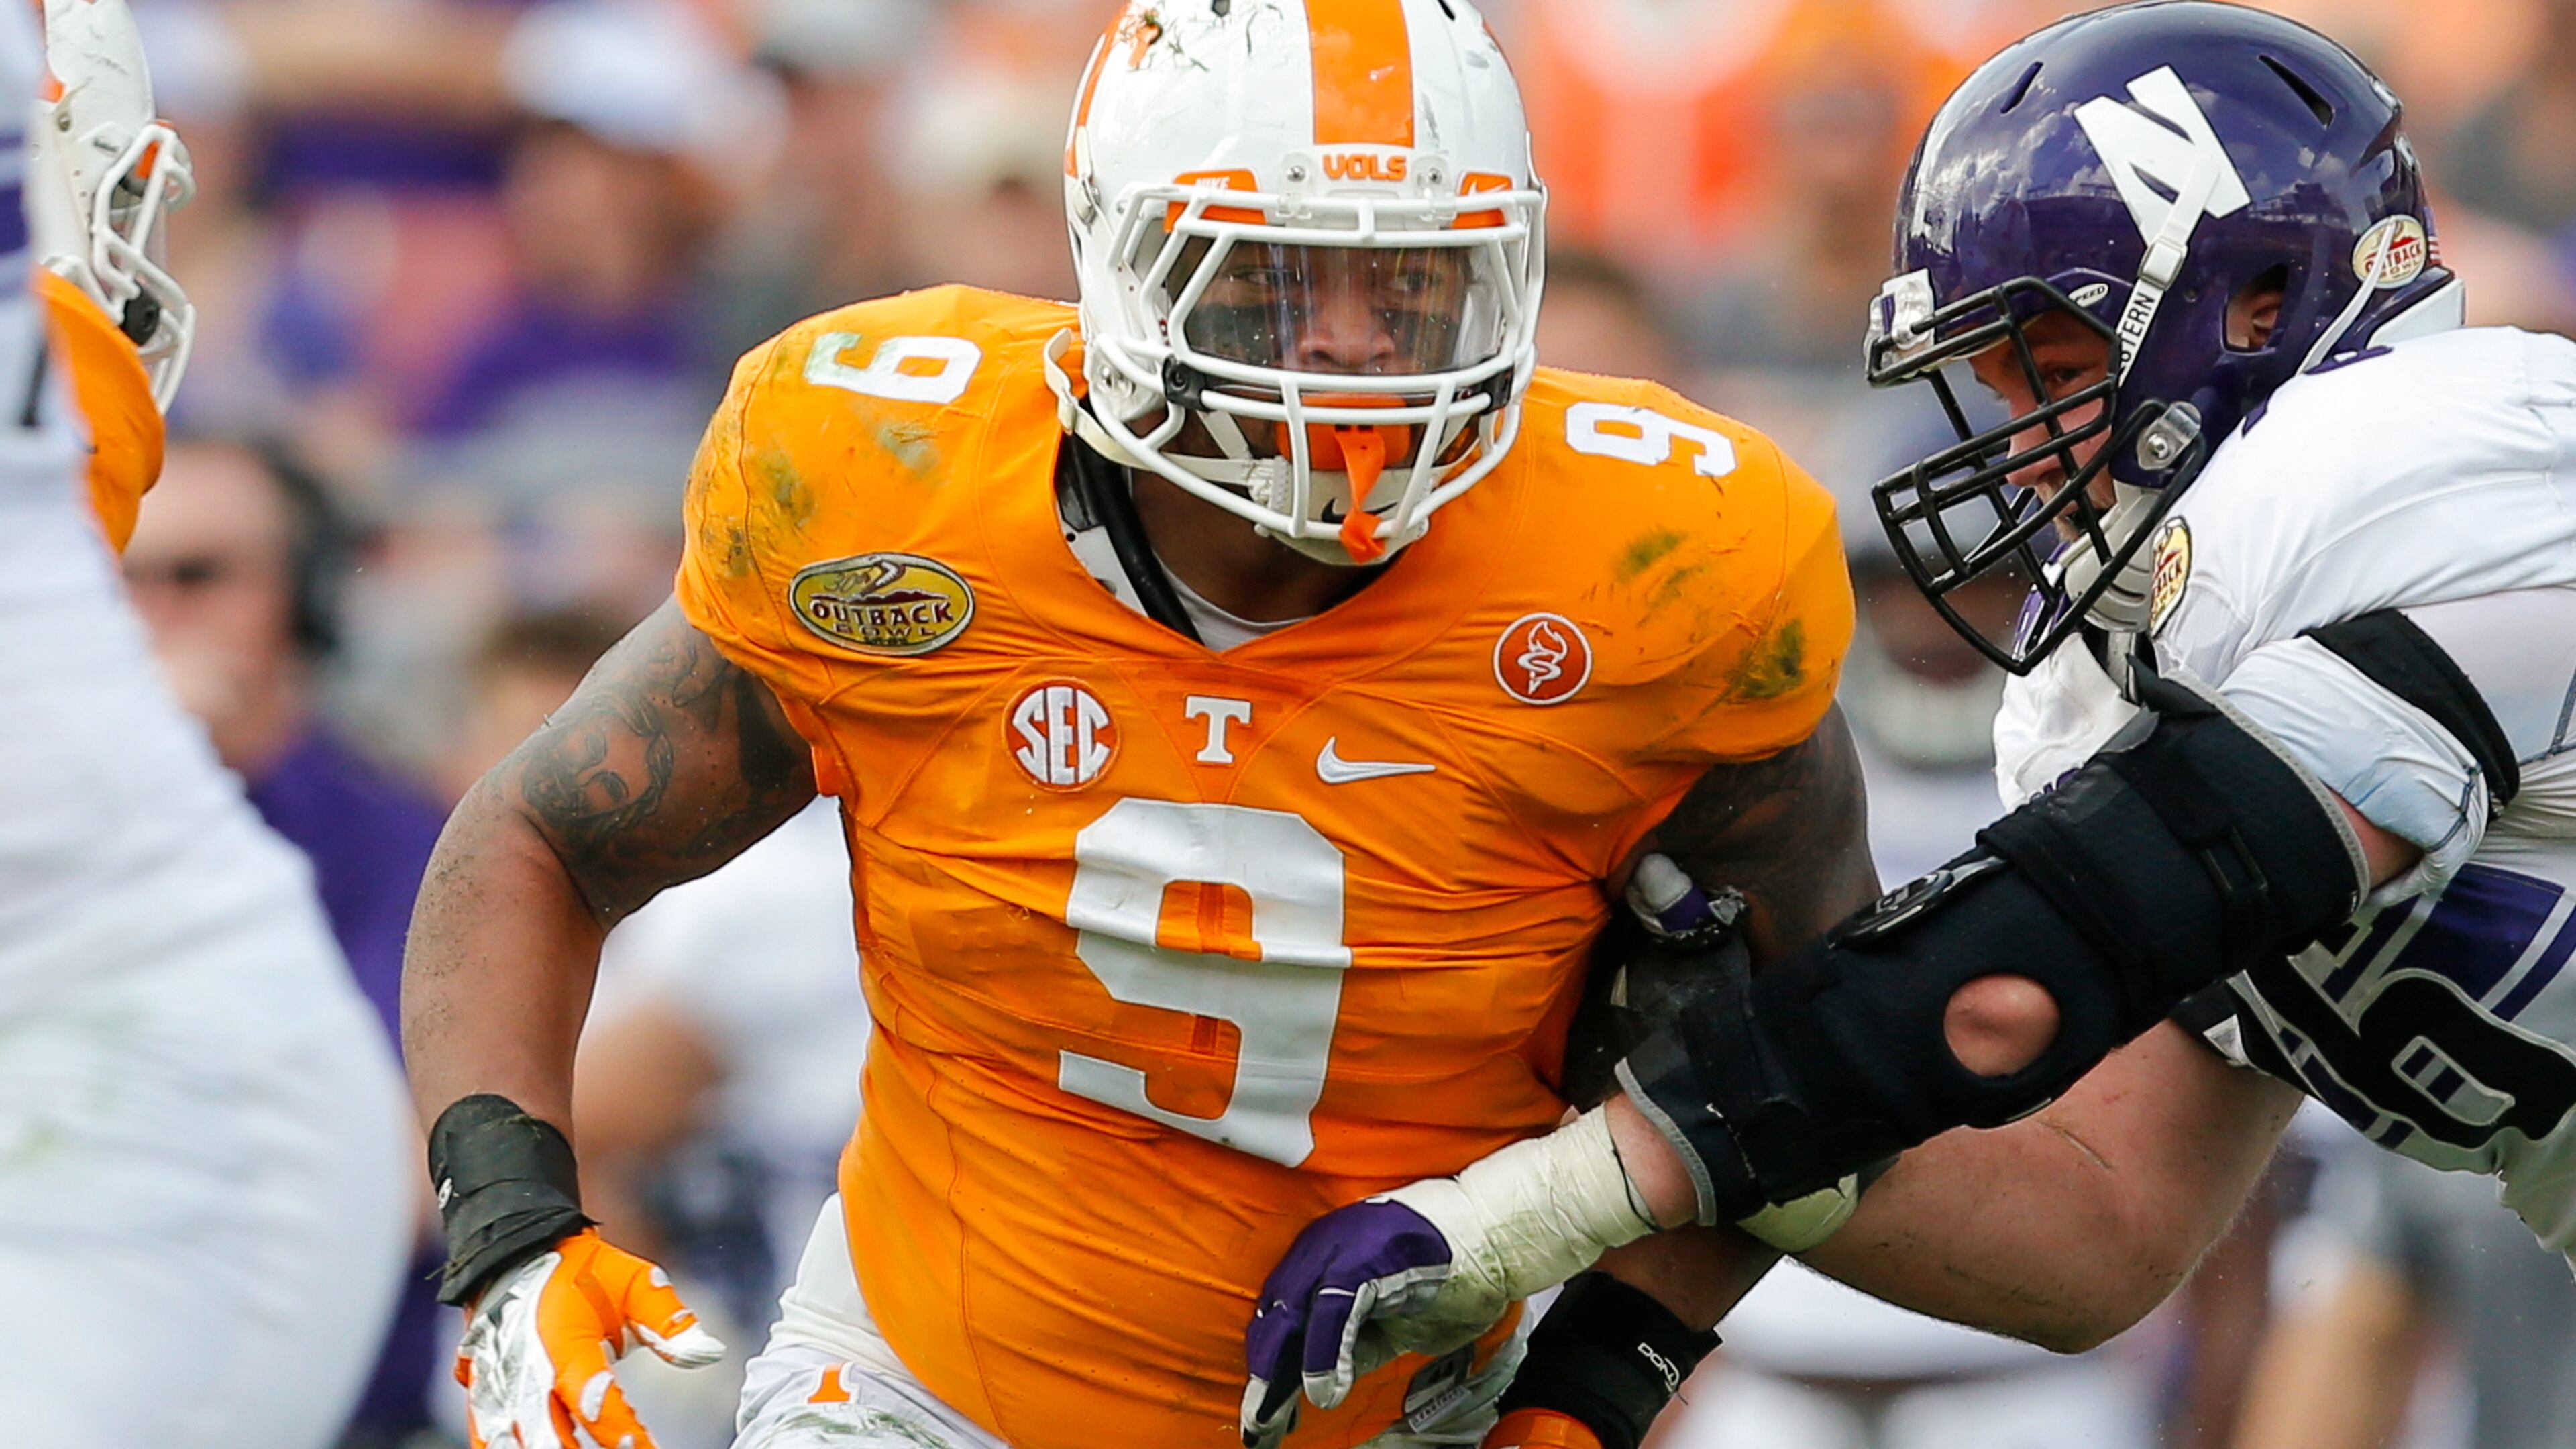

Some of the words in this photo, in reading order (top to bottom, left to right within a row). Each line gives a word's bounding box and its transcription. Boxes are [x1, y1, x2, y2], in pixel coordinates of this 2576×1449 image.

[1322, 154, 1407, 182] VOLS
[2074, 64, 2251, 247] N
[2365, 243, 2422, 274] OTBACK
[804, 331, 983, 405] 9
[1565, 400, 1737, 477] 9
[810, 600, 954, 627] OUTBACK
[833, 623, 937, 637] BOWL
[1012, 686, 1111, 786] SEC
[1186, 696, 1252, 763] T
[1058, 796, 1354, 1169] 9
